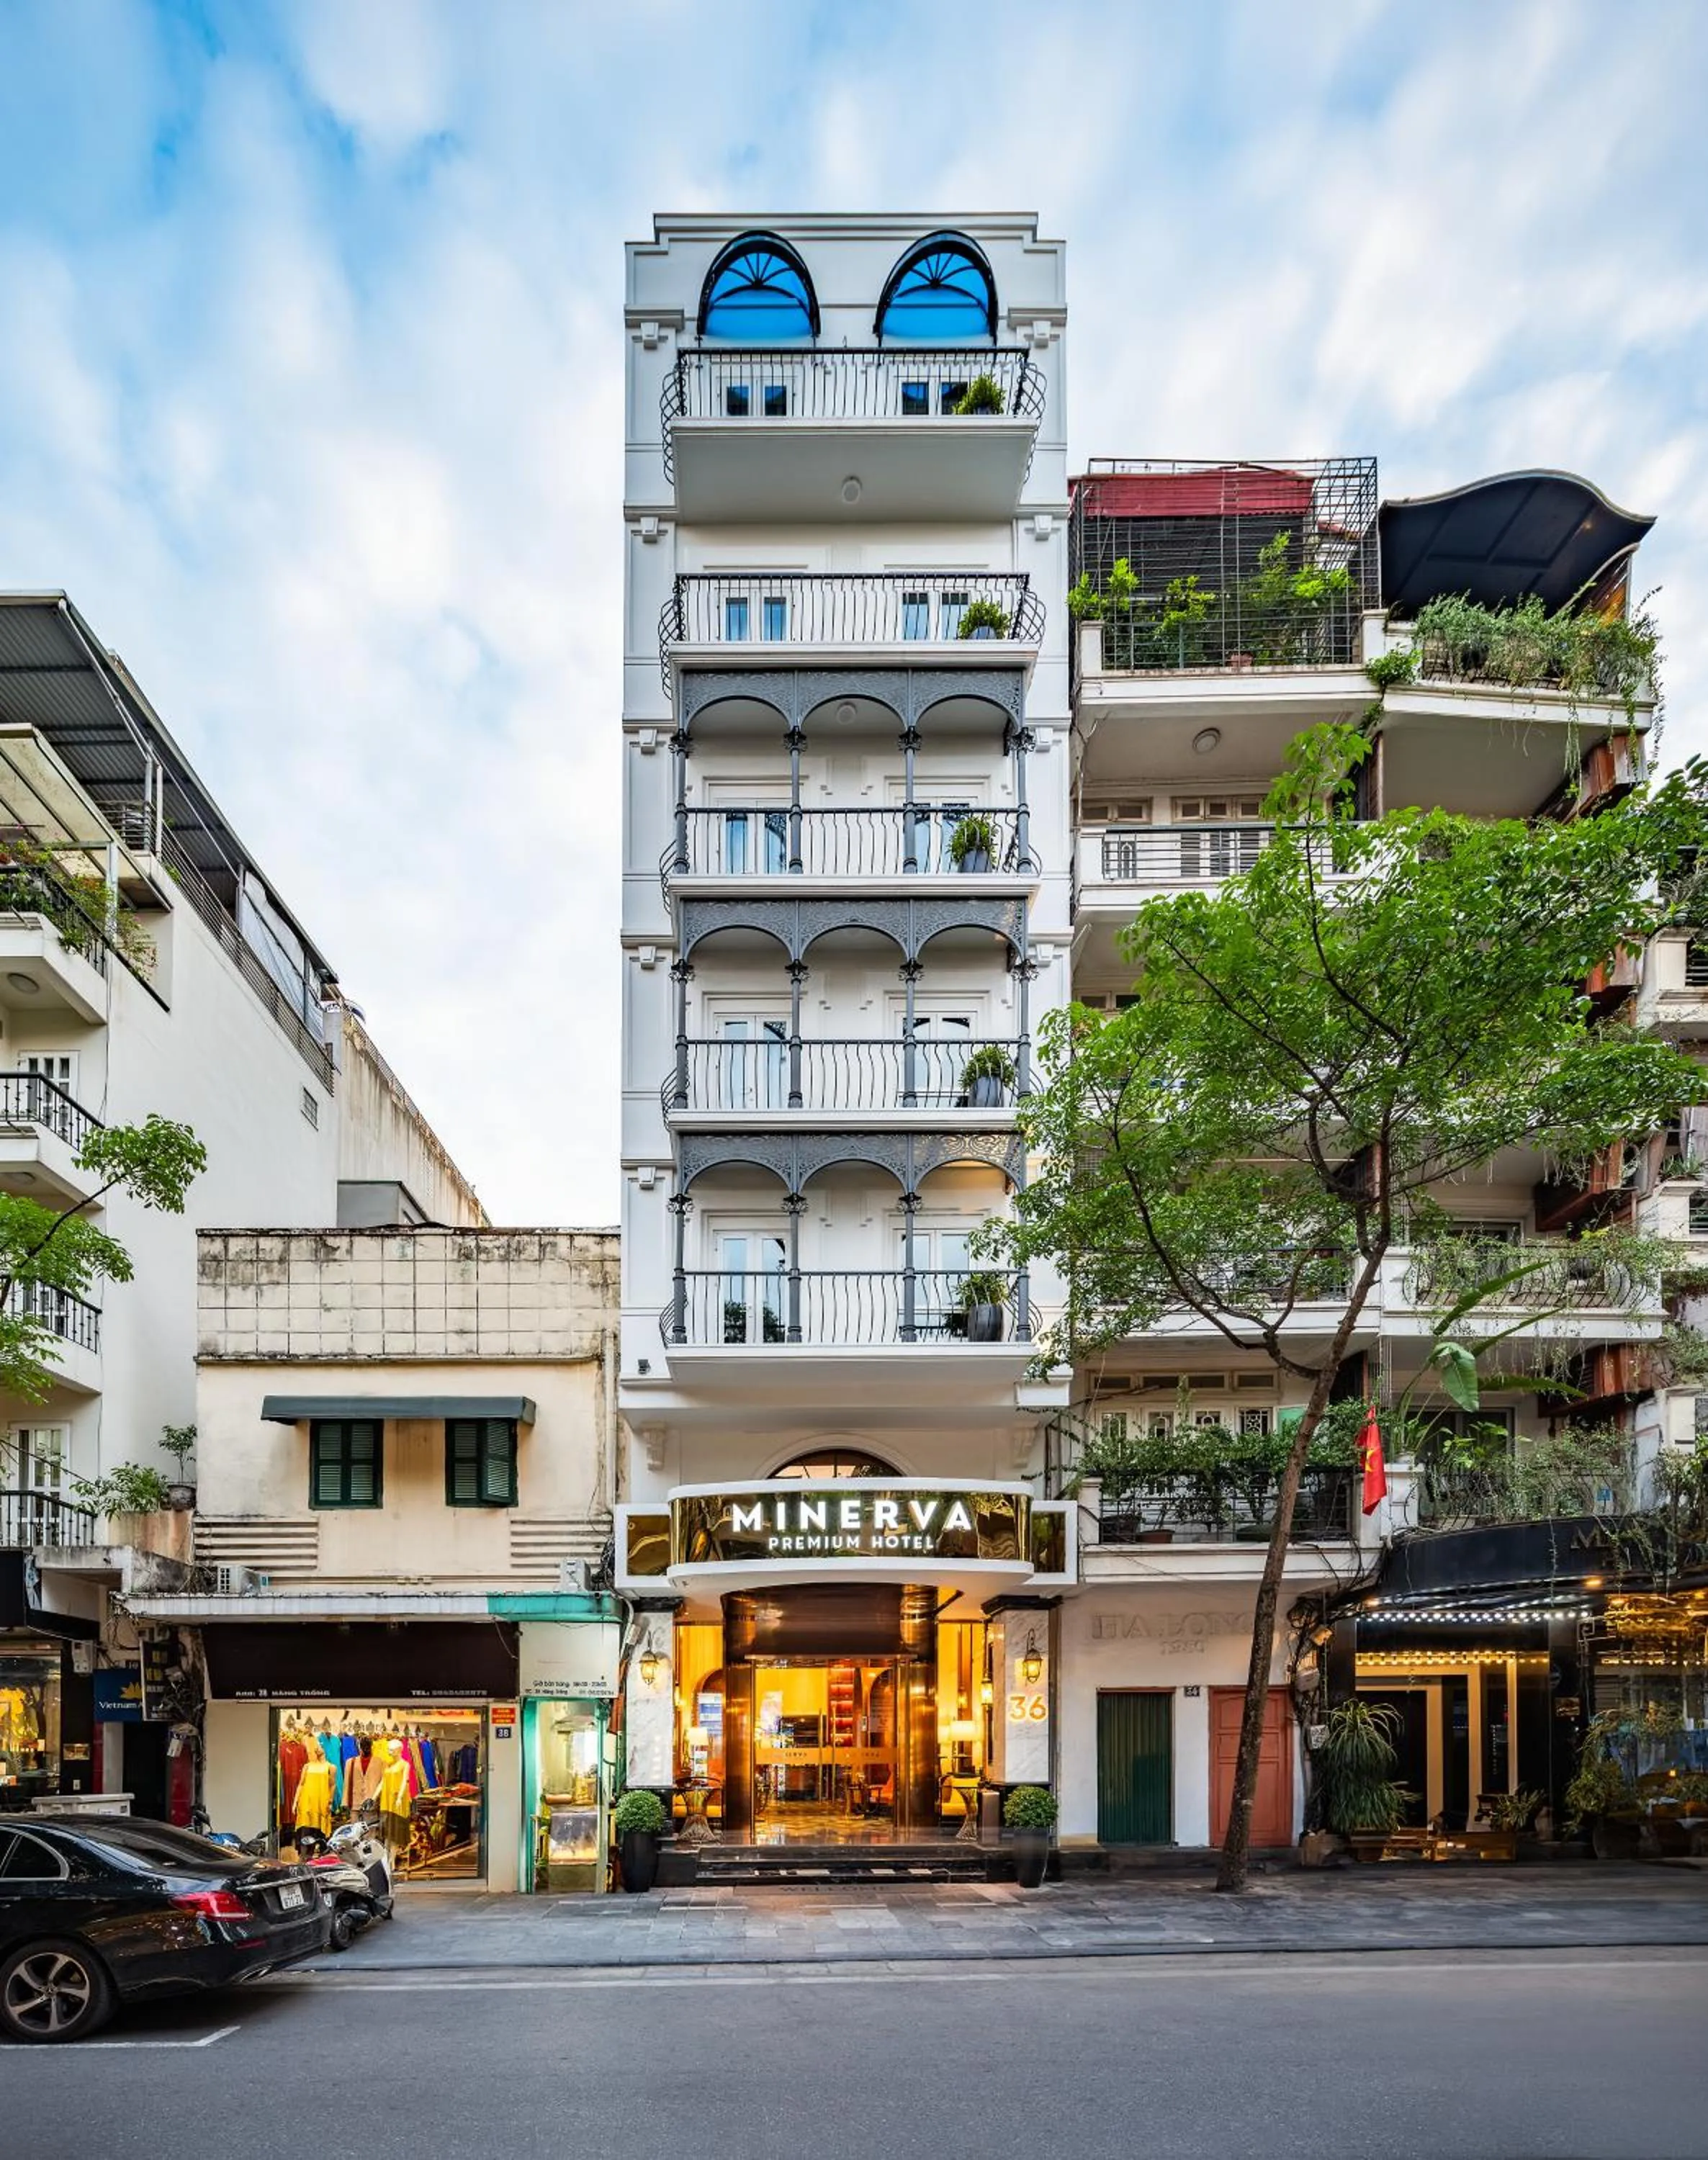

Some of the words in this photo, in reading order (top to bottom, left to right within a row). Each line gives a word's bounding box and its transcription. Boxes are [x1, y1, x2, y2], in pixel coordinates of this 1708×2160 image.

[732, 1500, 972, 1531] MINERVA
[769, 1536, 860, 1549] PREMIUM
[872, 1536, 934, 1549] HOTEL
[1010, 1696, 1046, 1720] 36
[498, 1729, 509, 1737] 38
